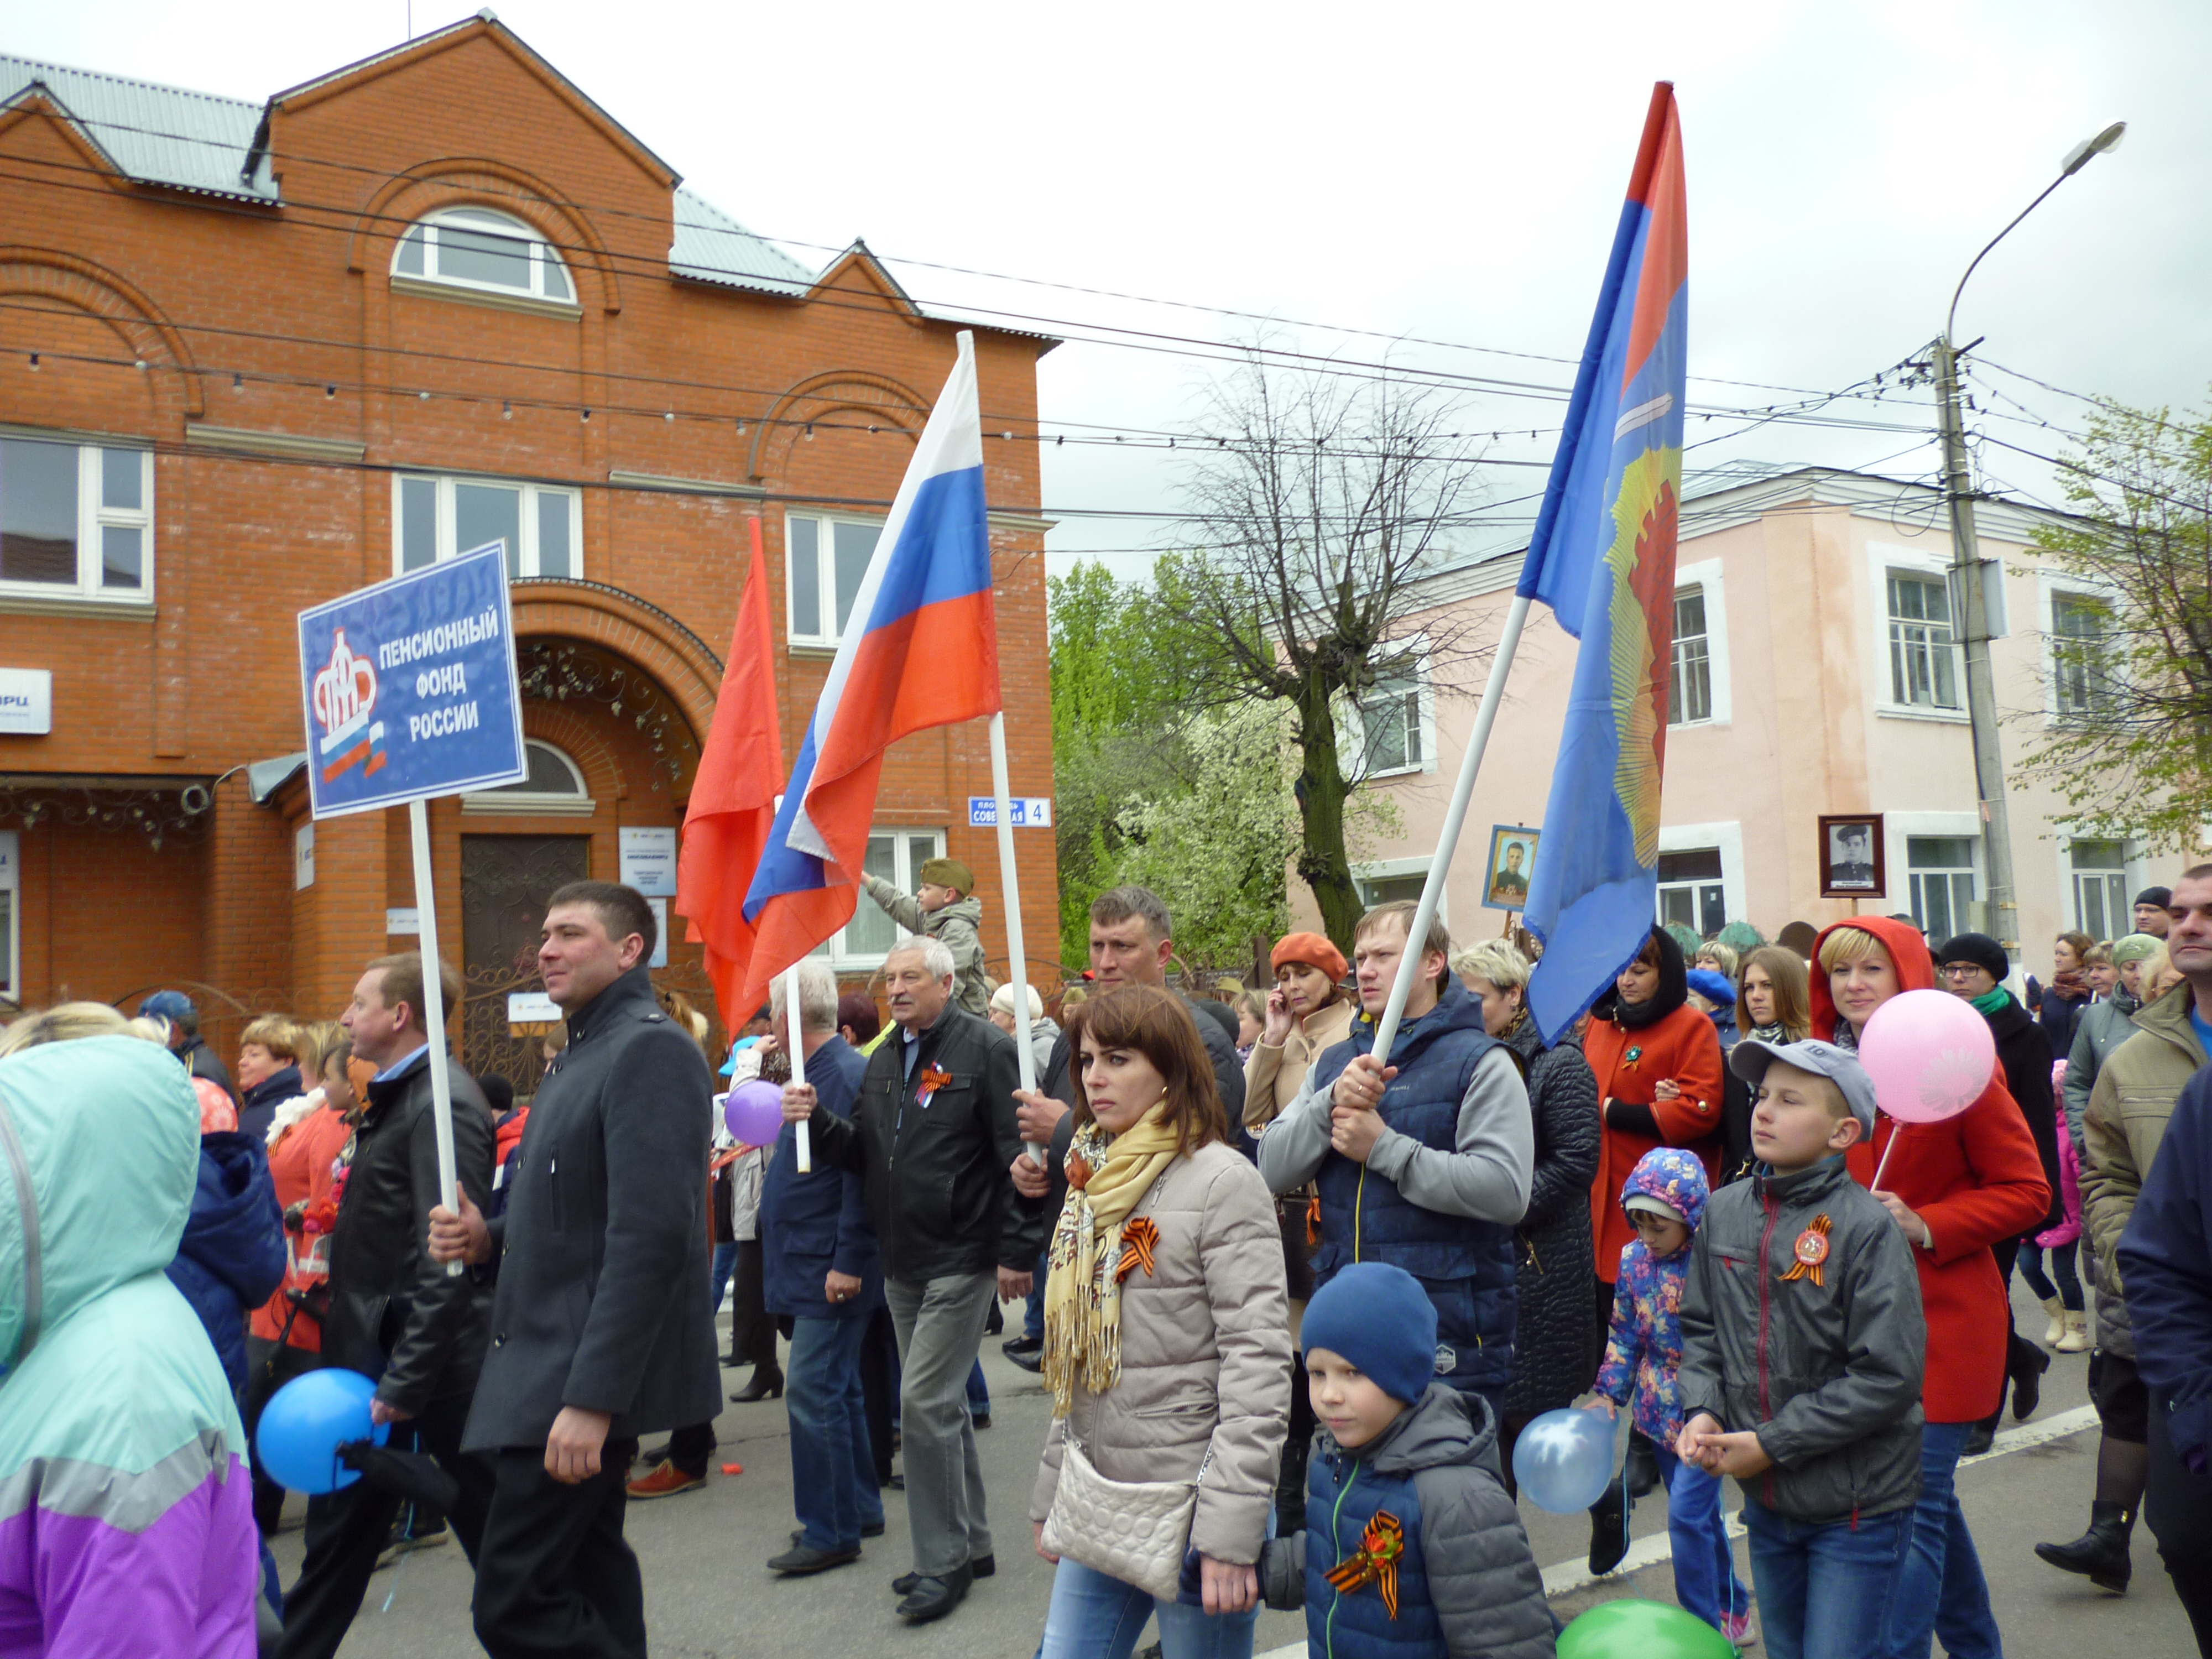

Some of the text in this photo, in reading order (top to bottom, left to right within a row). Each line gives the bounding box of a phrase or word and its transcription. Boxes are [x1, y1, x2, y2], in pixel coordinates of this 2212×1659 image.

[380, 604, 498, 670] ПЕНСИОННЫЙ
[416, 662, 467, 699] ФОНД
[410, 700, 479, 742] РОССИИ
[973, 811, 1023, 822] СОВЕАЯ
[1033, 804, 1042, 821] 4
